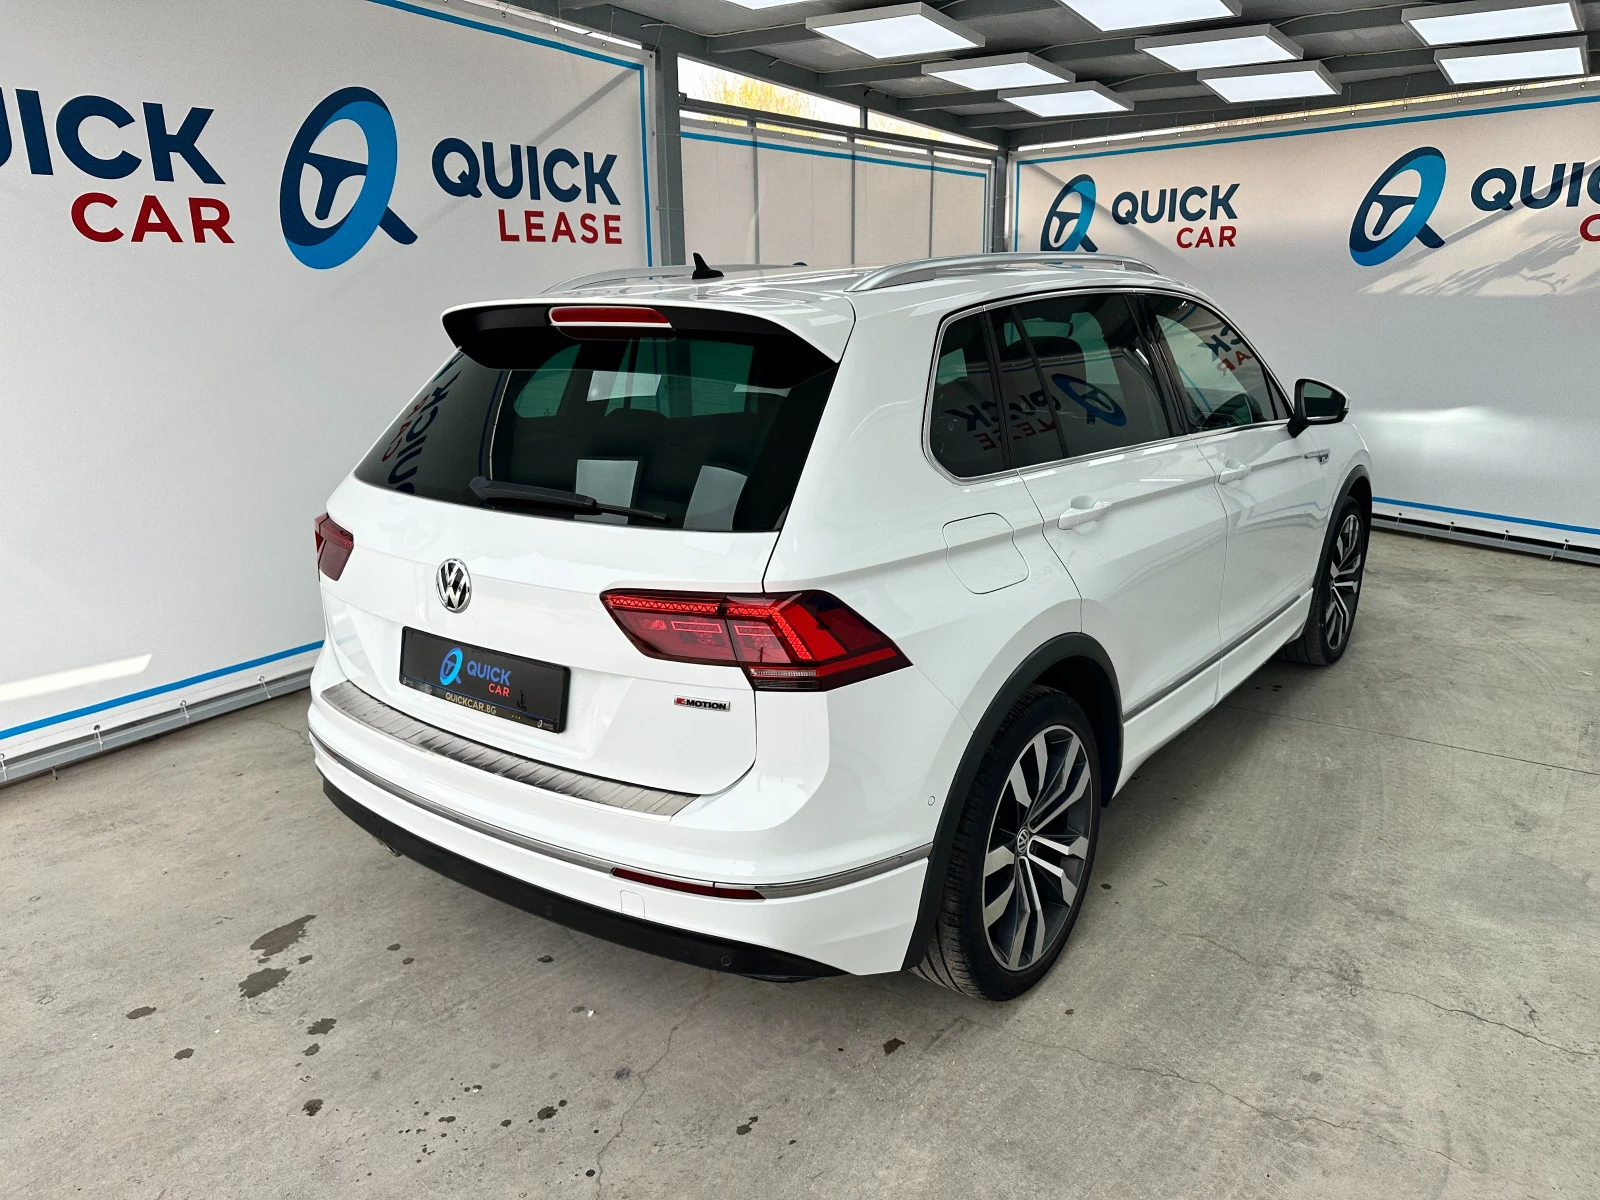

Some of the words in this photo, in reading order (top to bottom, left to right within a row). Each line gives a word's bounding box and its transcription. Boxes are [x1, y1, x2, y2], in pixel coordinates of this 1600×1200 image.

[0, 86, 226, 185] ICK
[431, 137, 622, 206] QUICK
[71, 192, 235, 244] CAR
[1111, 183, 1241, 225] QUICK
[498, 209, 622, 245] LEASE
[1176, 225, 1237, 248] CAR
[467, 660, 512, 686] QUICK
[488, 682, 510, 698] CAR
[445, 692, 497, 715] QUICKCAR.BG
